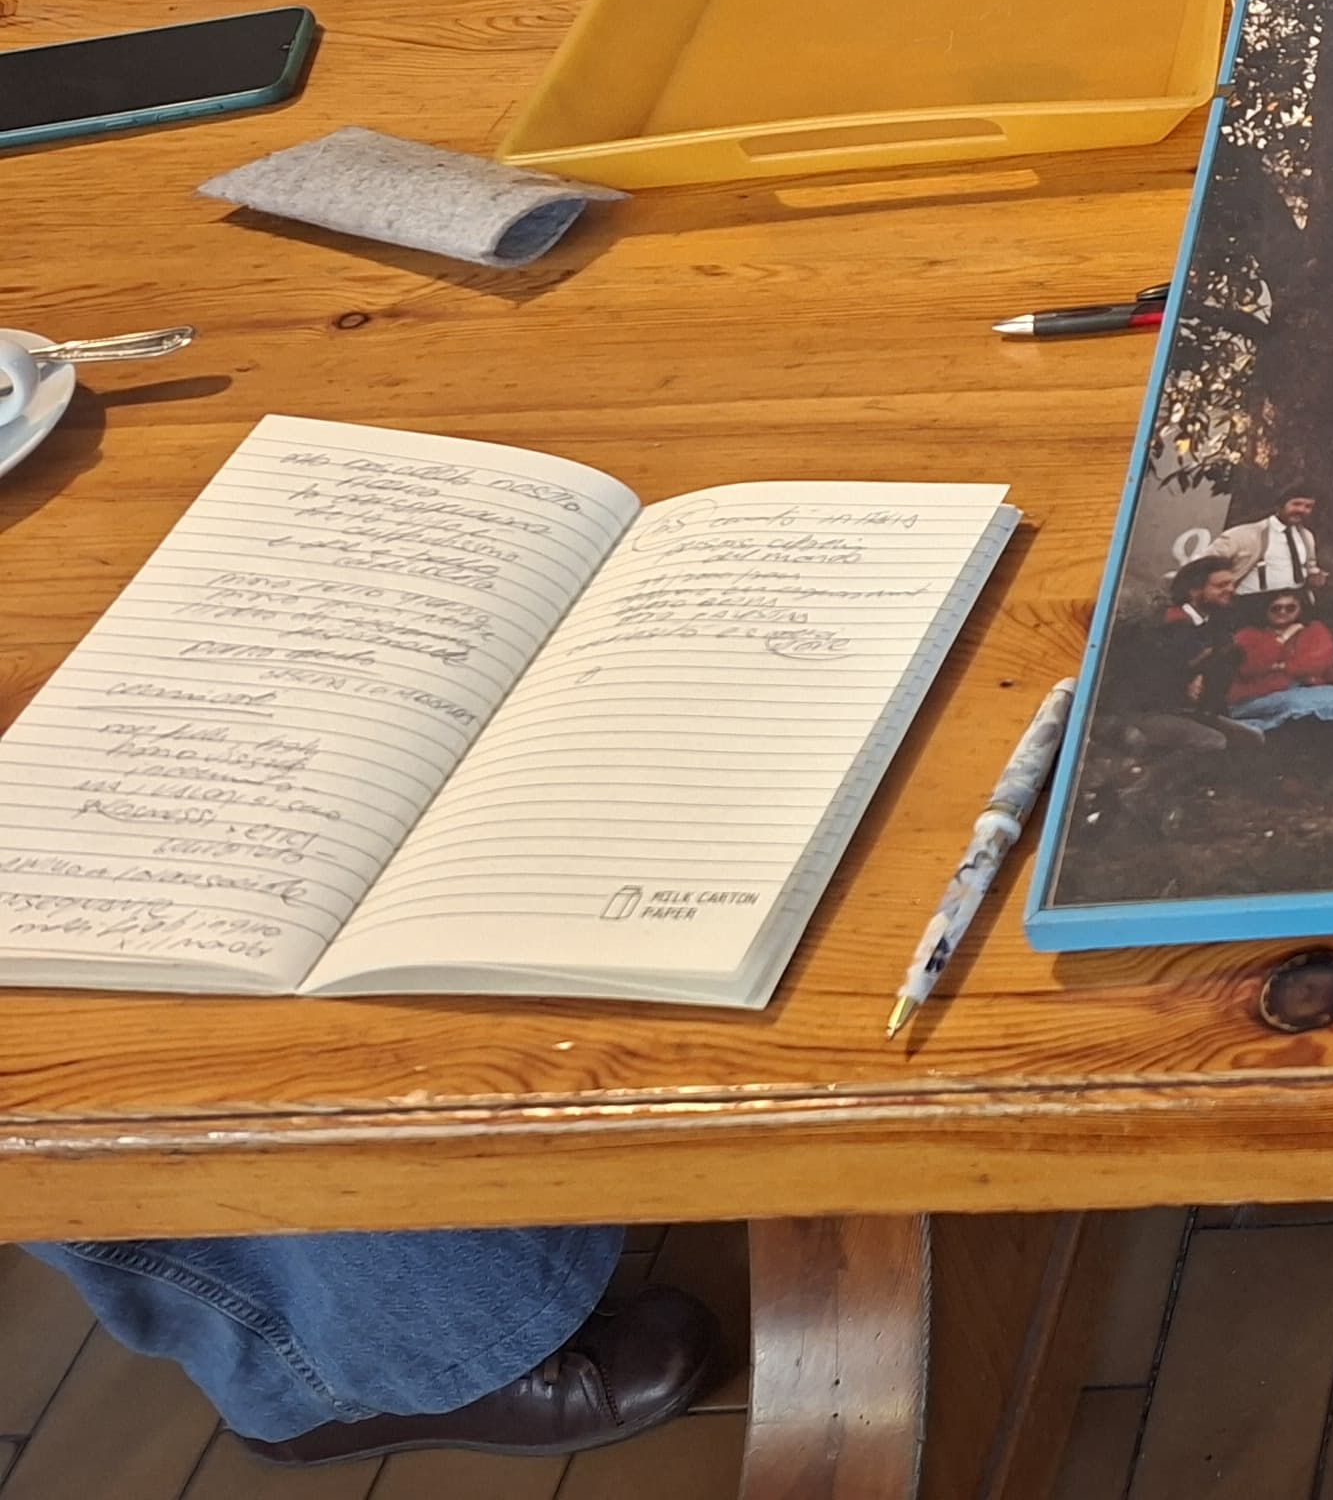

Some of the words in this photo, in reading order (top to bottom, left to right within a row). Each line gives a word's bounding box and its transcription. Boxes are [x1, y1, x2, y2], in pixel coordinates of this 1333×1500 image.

[651, 890, 693, 903] MILK
[697, 891, 760, 905] CARTON
[641, 906, 698, 920] PAPER
